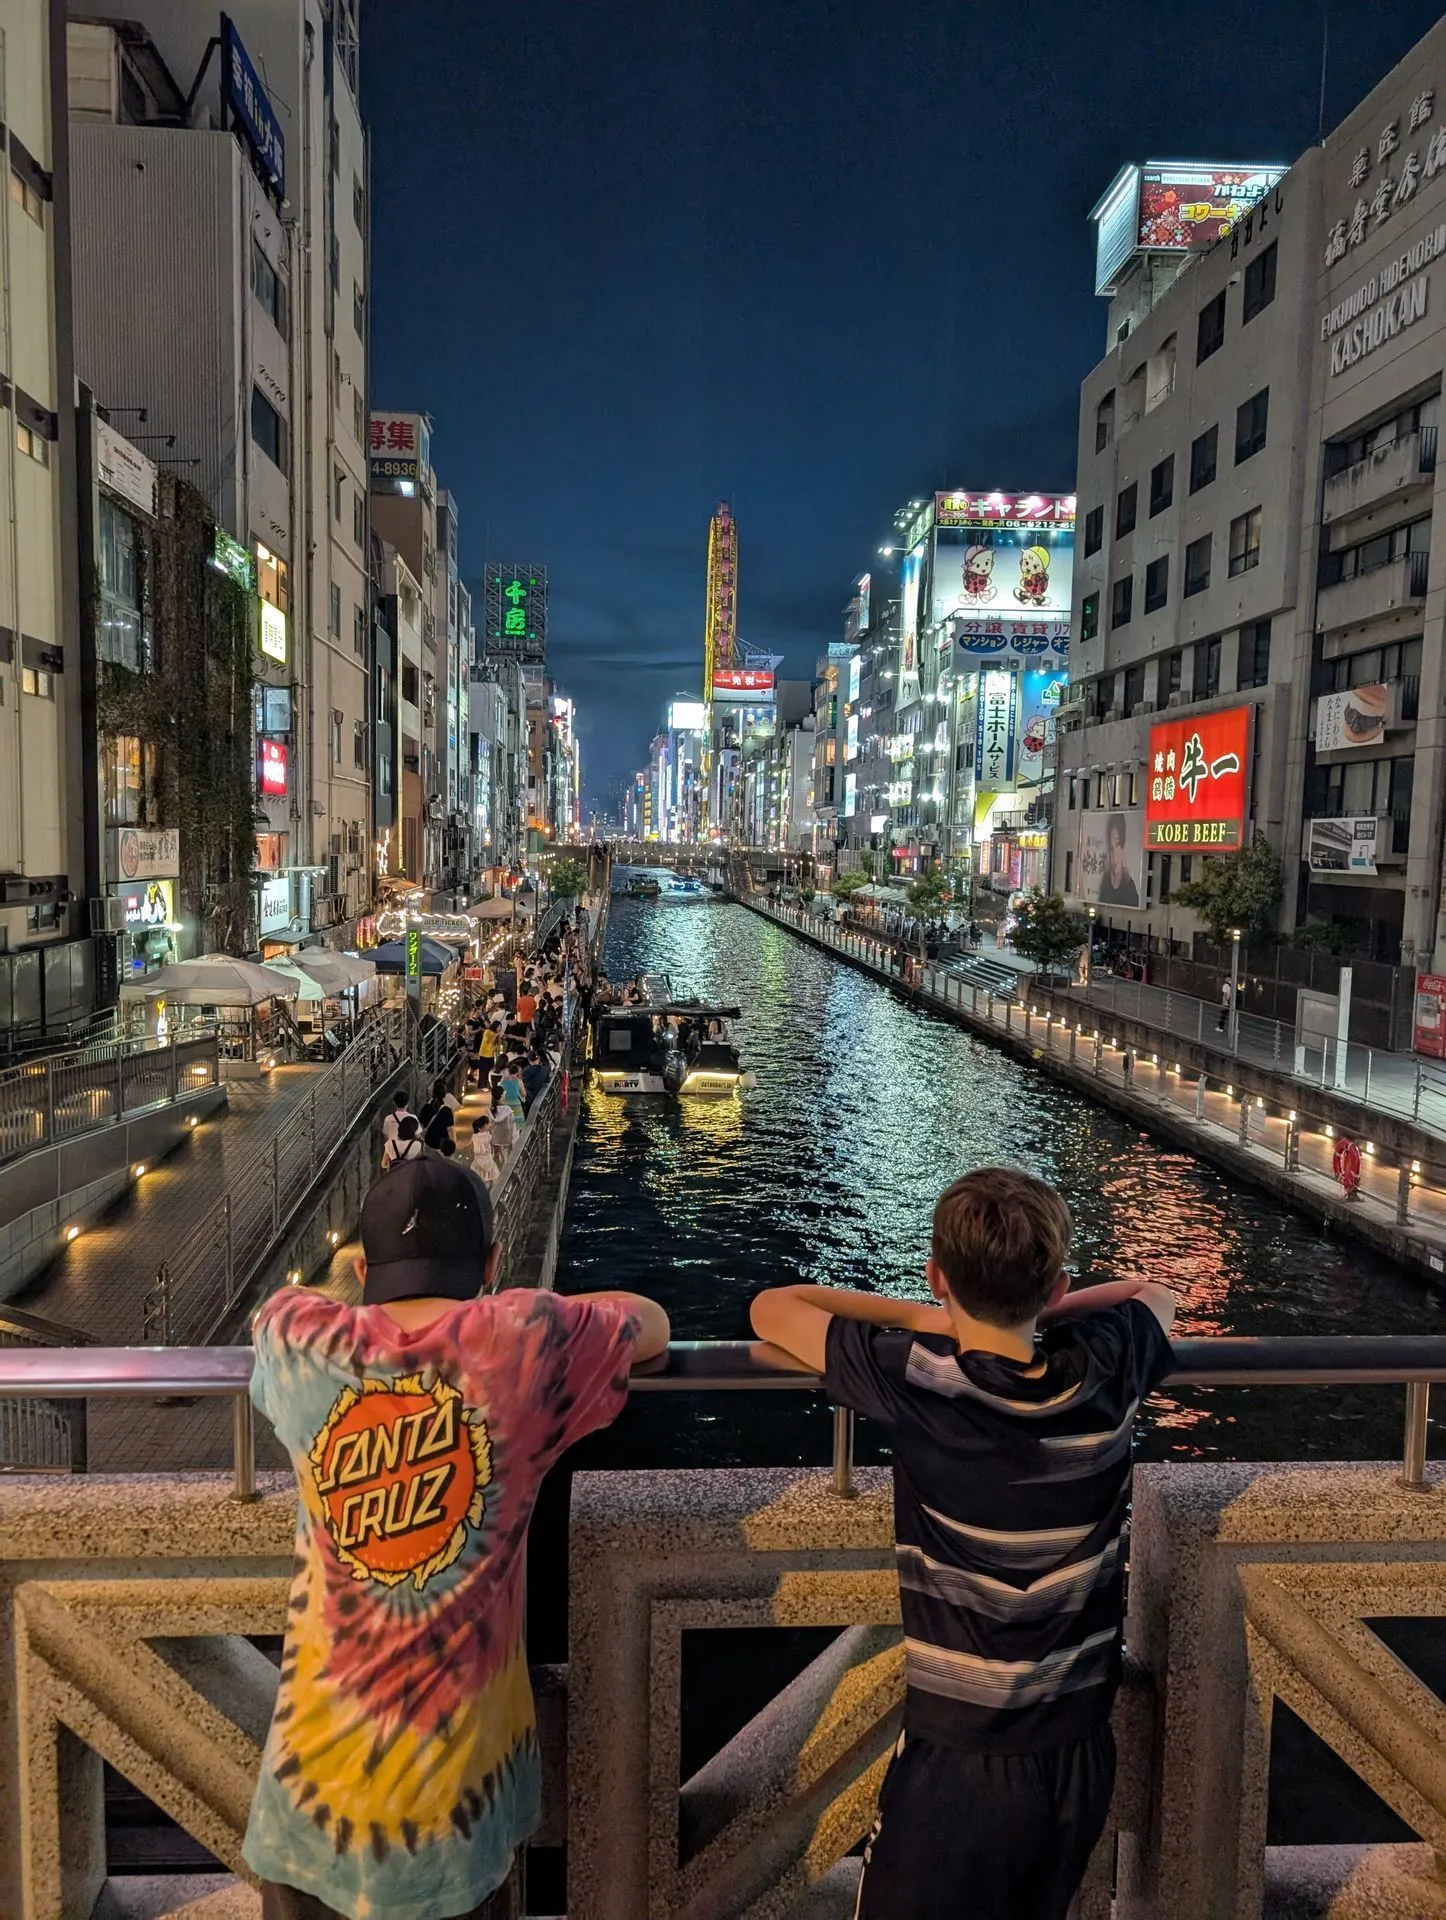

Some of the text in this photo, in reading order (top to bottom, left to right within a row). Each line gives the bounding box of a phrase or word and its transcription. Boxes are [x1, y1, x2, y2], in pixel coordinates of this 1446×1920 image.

[1144, 174, 1161, 182] search
[1330, 277, 1428, 377] KASHOKAN
[371, 420, 415, 451] 募集
[372, 461, 417, 476] 4-8936
[962, 636, 1005, 647] マンション
[1013, 637, 1047, 648] レジャー
[987, 692, 1006, 779] 富士ホームサービス
[1154, 733, 1239, 804] 焼肉 牛一
[1156, 823, 1226, 842] KOBE BEEF
[318, 1399, 459, 1493] SANTA
[339, 1464, 452, 1548] CRUZ
